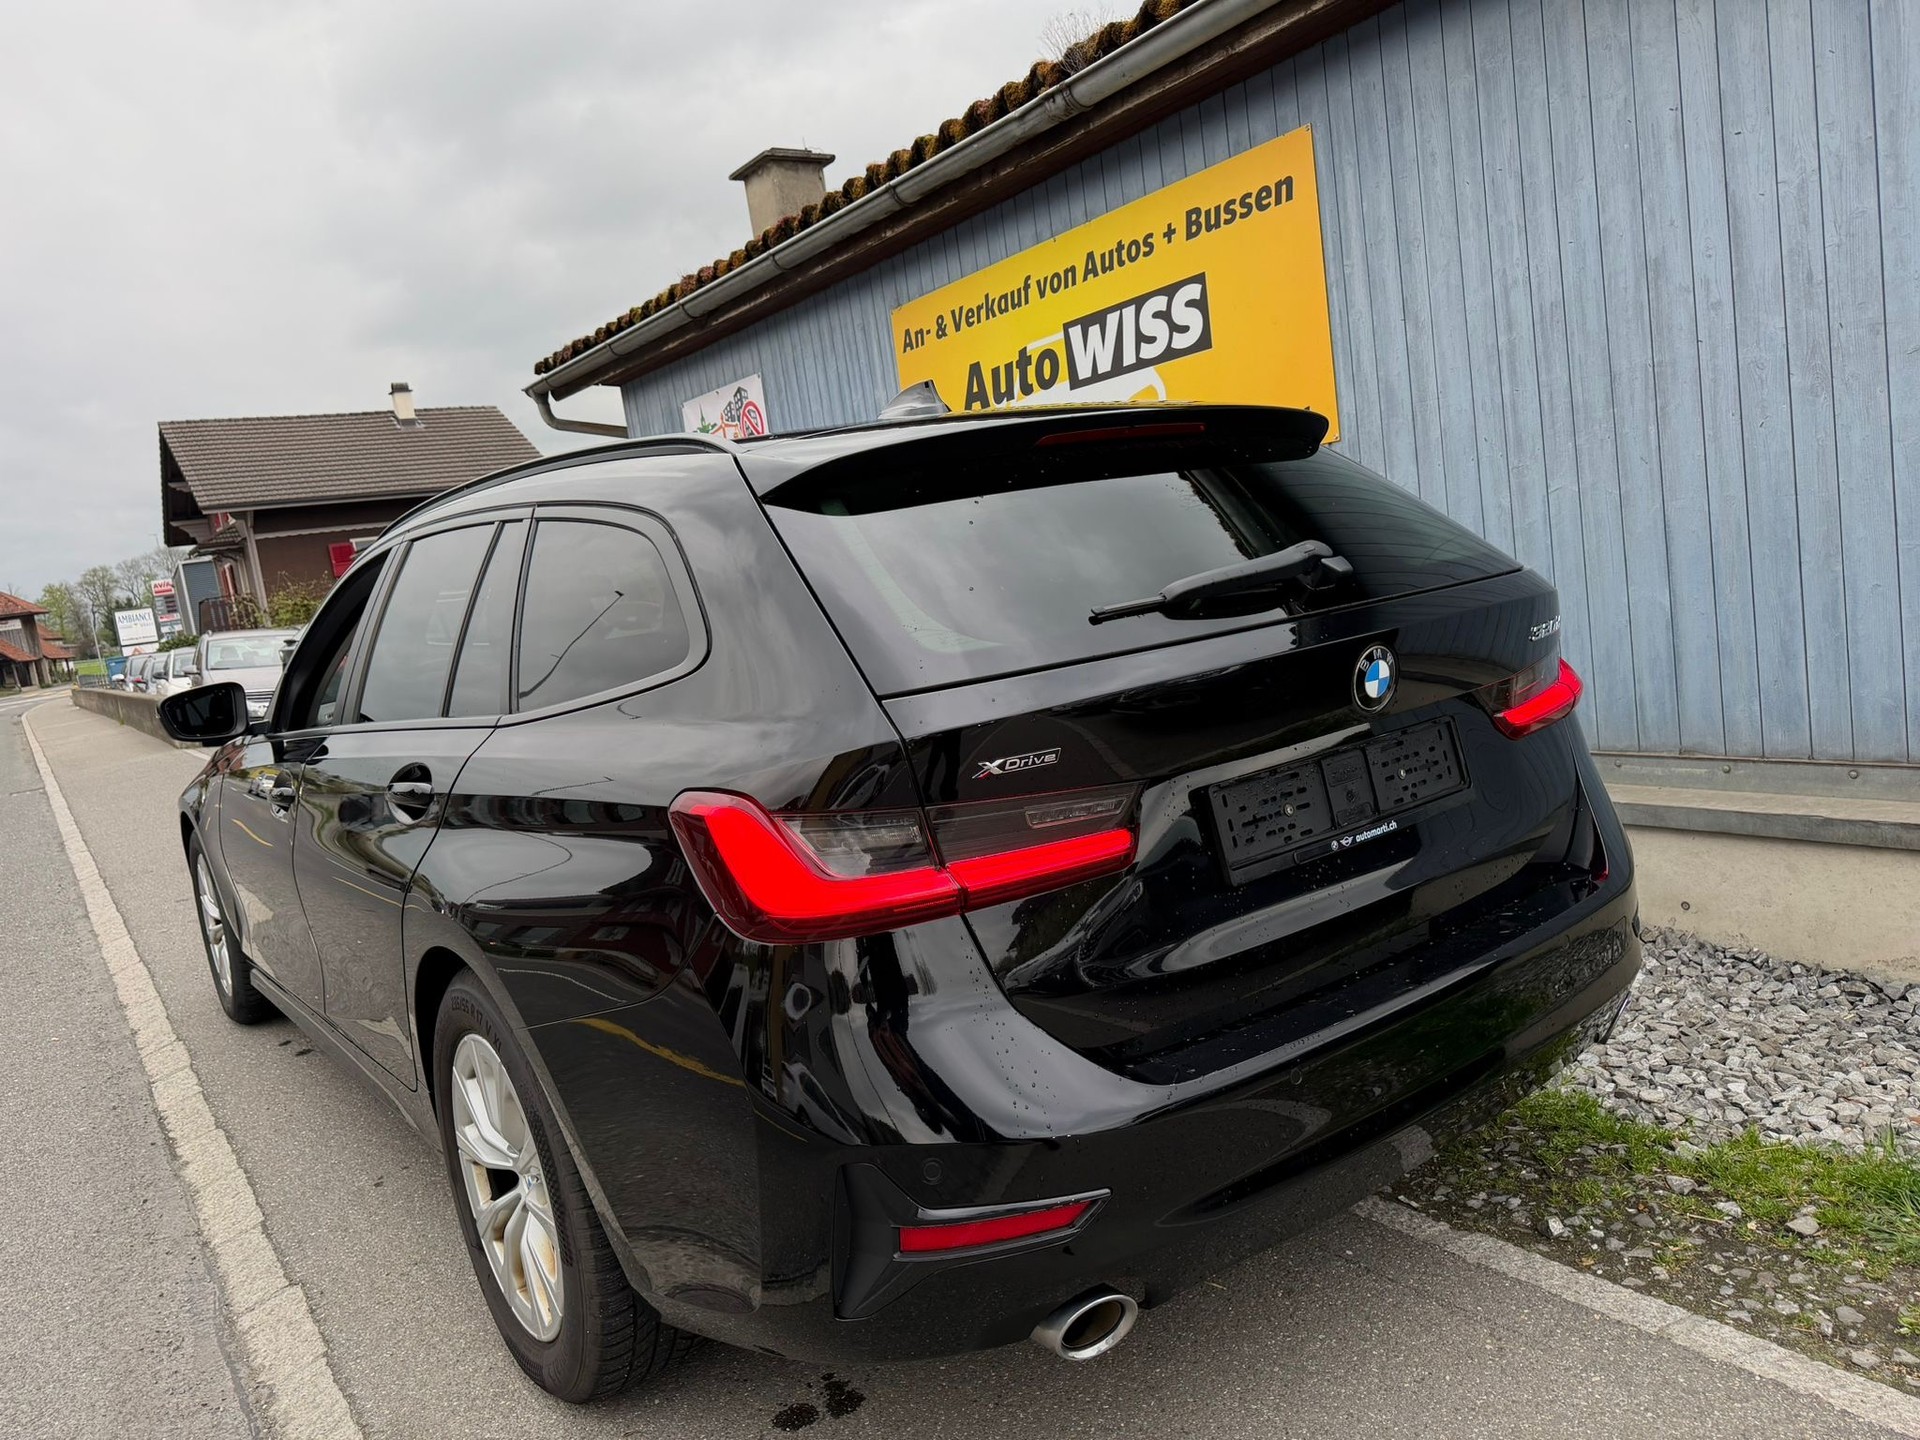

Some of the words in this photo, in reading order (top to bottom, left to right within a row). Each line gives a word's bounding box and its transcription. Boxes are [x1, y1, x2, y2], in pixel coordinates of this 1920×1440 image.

[902, 327, 931, 354] An-
[935, 314, 948, 339] &
[950, 275, 1033, 334] Verkauf
[1035, 264, 1078, 301] von
[1082, 231, 1155, 283] Autos
[1162, 222, 1177, 245] +
[1184, 174, 1295, 242] Bussen
[964, 344, 1061, 411] Auto
[1067, 282, 1206, 382] WISS
[153, 580, 173, 590] AVIA
[1359, 647, 1396, 672] BMW
[1355, 820, 1398, 842] automarti.ch
